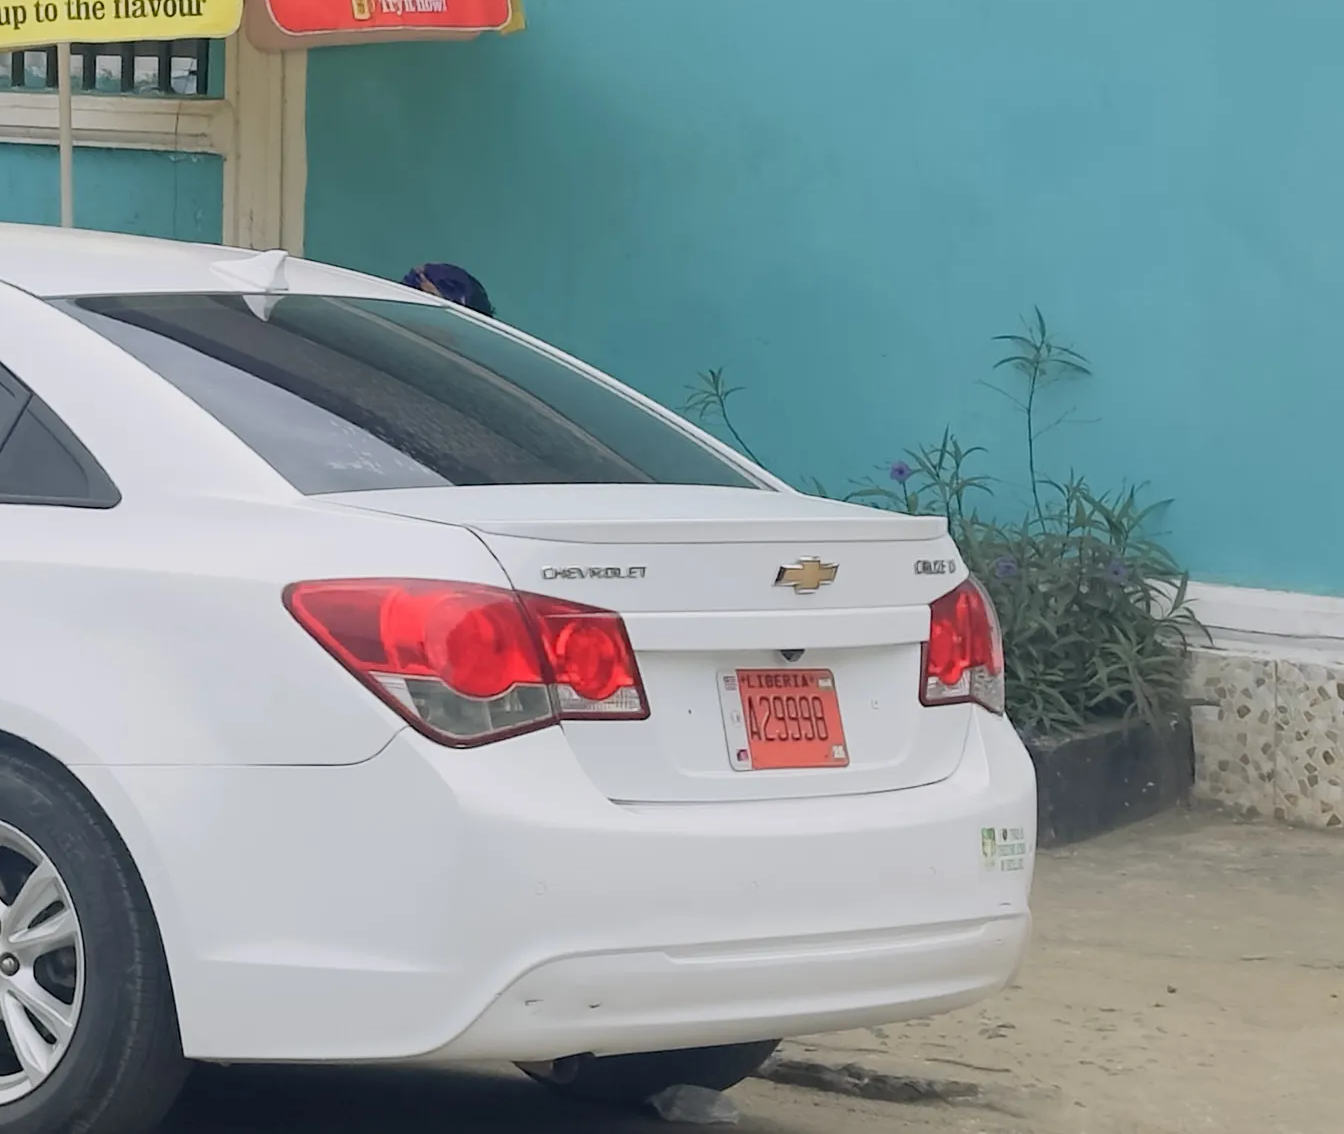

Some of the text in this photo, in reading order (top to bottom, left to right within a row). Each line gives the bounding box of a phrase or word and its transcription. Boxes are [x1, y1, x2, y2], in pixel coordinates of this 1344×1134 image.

[34, 0, 58, 23] to
[542, 565, 647, 580] CHEVROLET
[746, 674, 810, 689] LIBERIA
[747, 695, 829, 742] A29998
